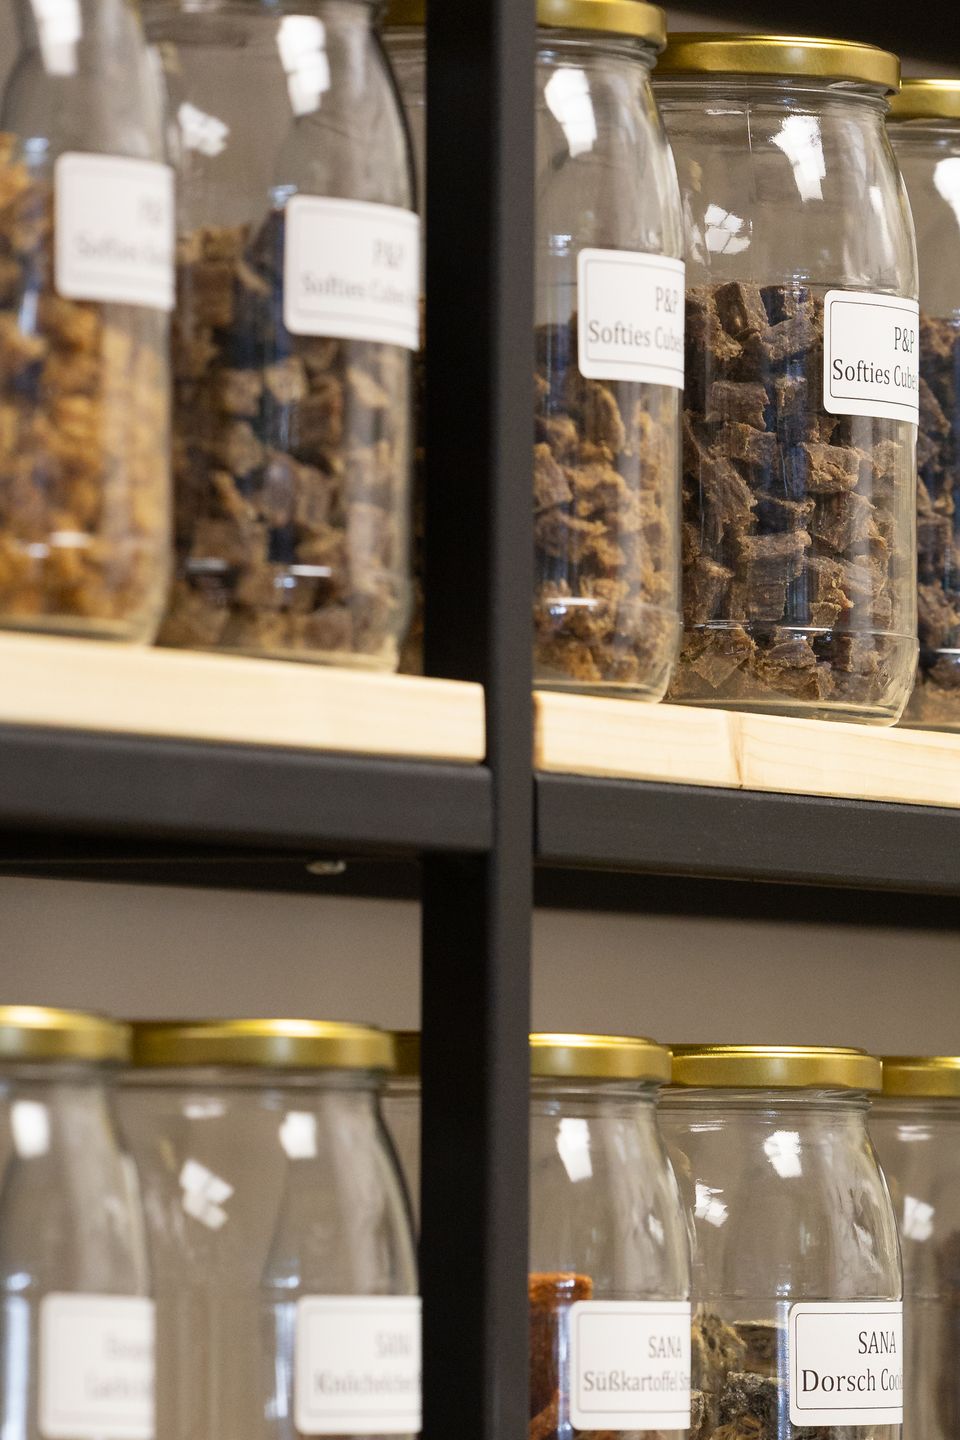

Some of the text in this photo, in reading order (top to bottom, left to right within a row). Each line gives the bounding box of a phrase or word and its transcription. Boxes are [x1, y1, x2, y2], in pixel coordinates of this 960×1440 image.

[655, 286, 679, 314] P&P
[588, 320, 651, 347] Softies
[894, 326, 915, 353] P&P
[832, 359, 919, 390] Softies Cube
[648, 1335, 683, 1359] SANA
[858, 1331, 897, 1354] SANA
[583, 1370, 677, 1392] Süßkartoffel
[802, 1368, 903, 1392] Dorsch Coo
